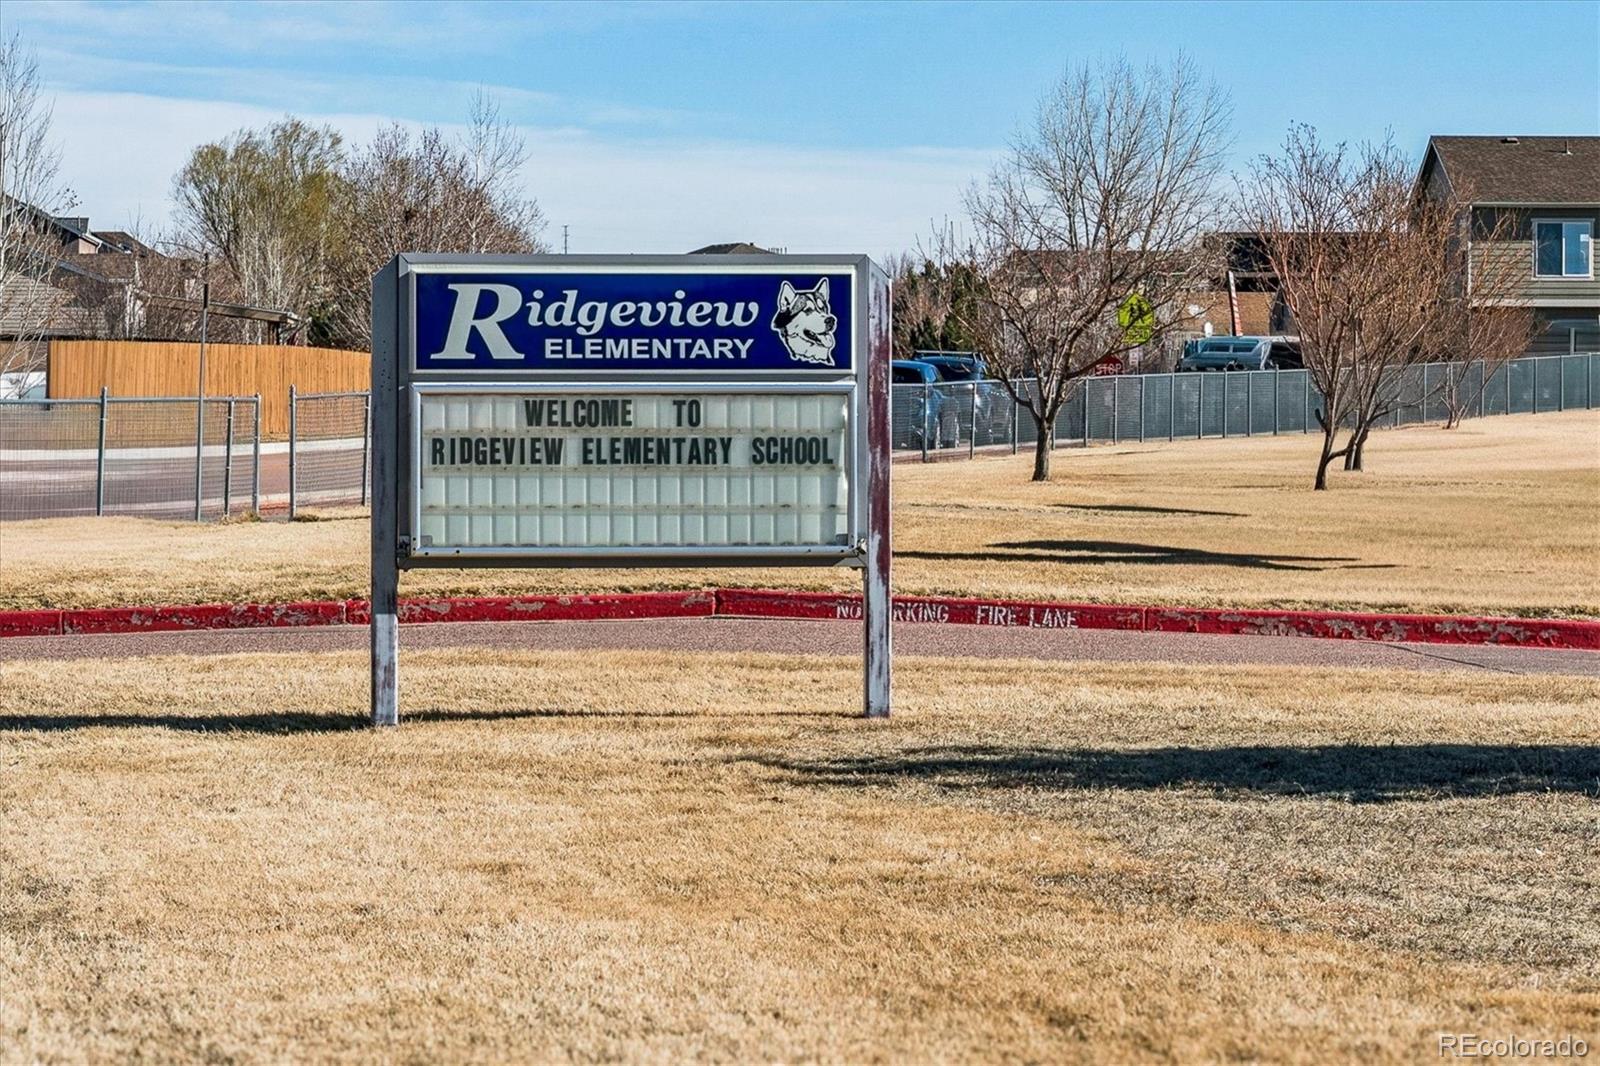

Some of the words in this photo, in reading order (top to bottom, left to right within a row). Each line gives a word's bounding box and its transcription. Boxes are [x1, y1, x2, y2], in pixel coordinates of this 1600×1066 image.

[430, 283, 759, 360] Ridgeview
[544, 338, 754, 359] ELEMENTARY
[524, 399, 632, 427] WELCOME
[673, 399, 701, 427] TO
[431, 437, 564, 465] RIDGEVIEW
[582, 437, 732, 465] ELEMENTARY
[752, 437, 834, 465] SCHOOL
[836, 600, 862, 618] NO
[892, 602, 949, 622] RKING
[976, 605, 1017, 626] FIRE
[1029, 607, 1078, 628] LANE
